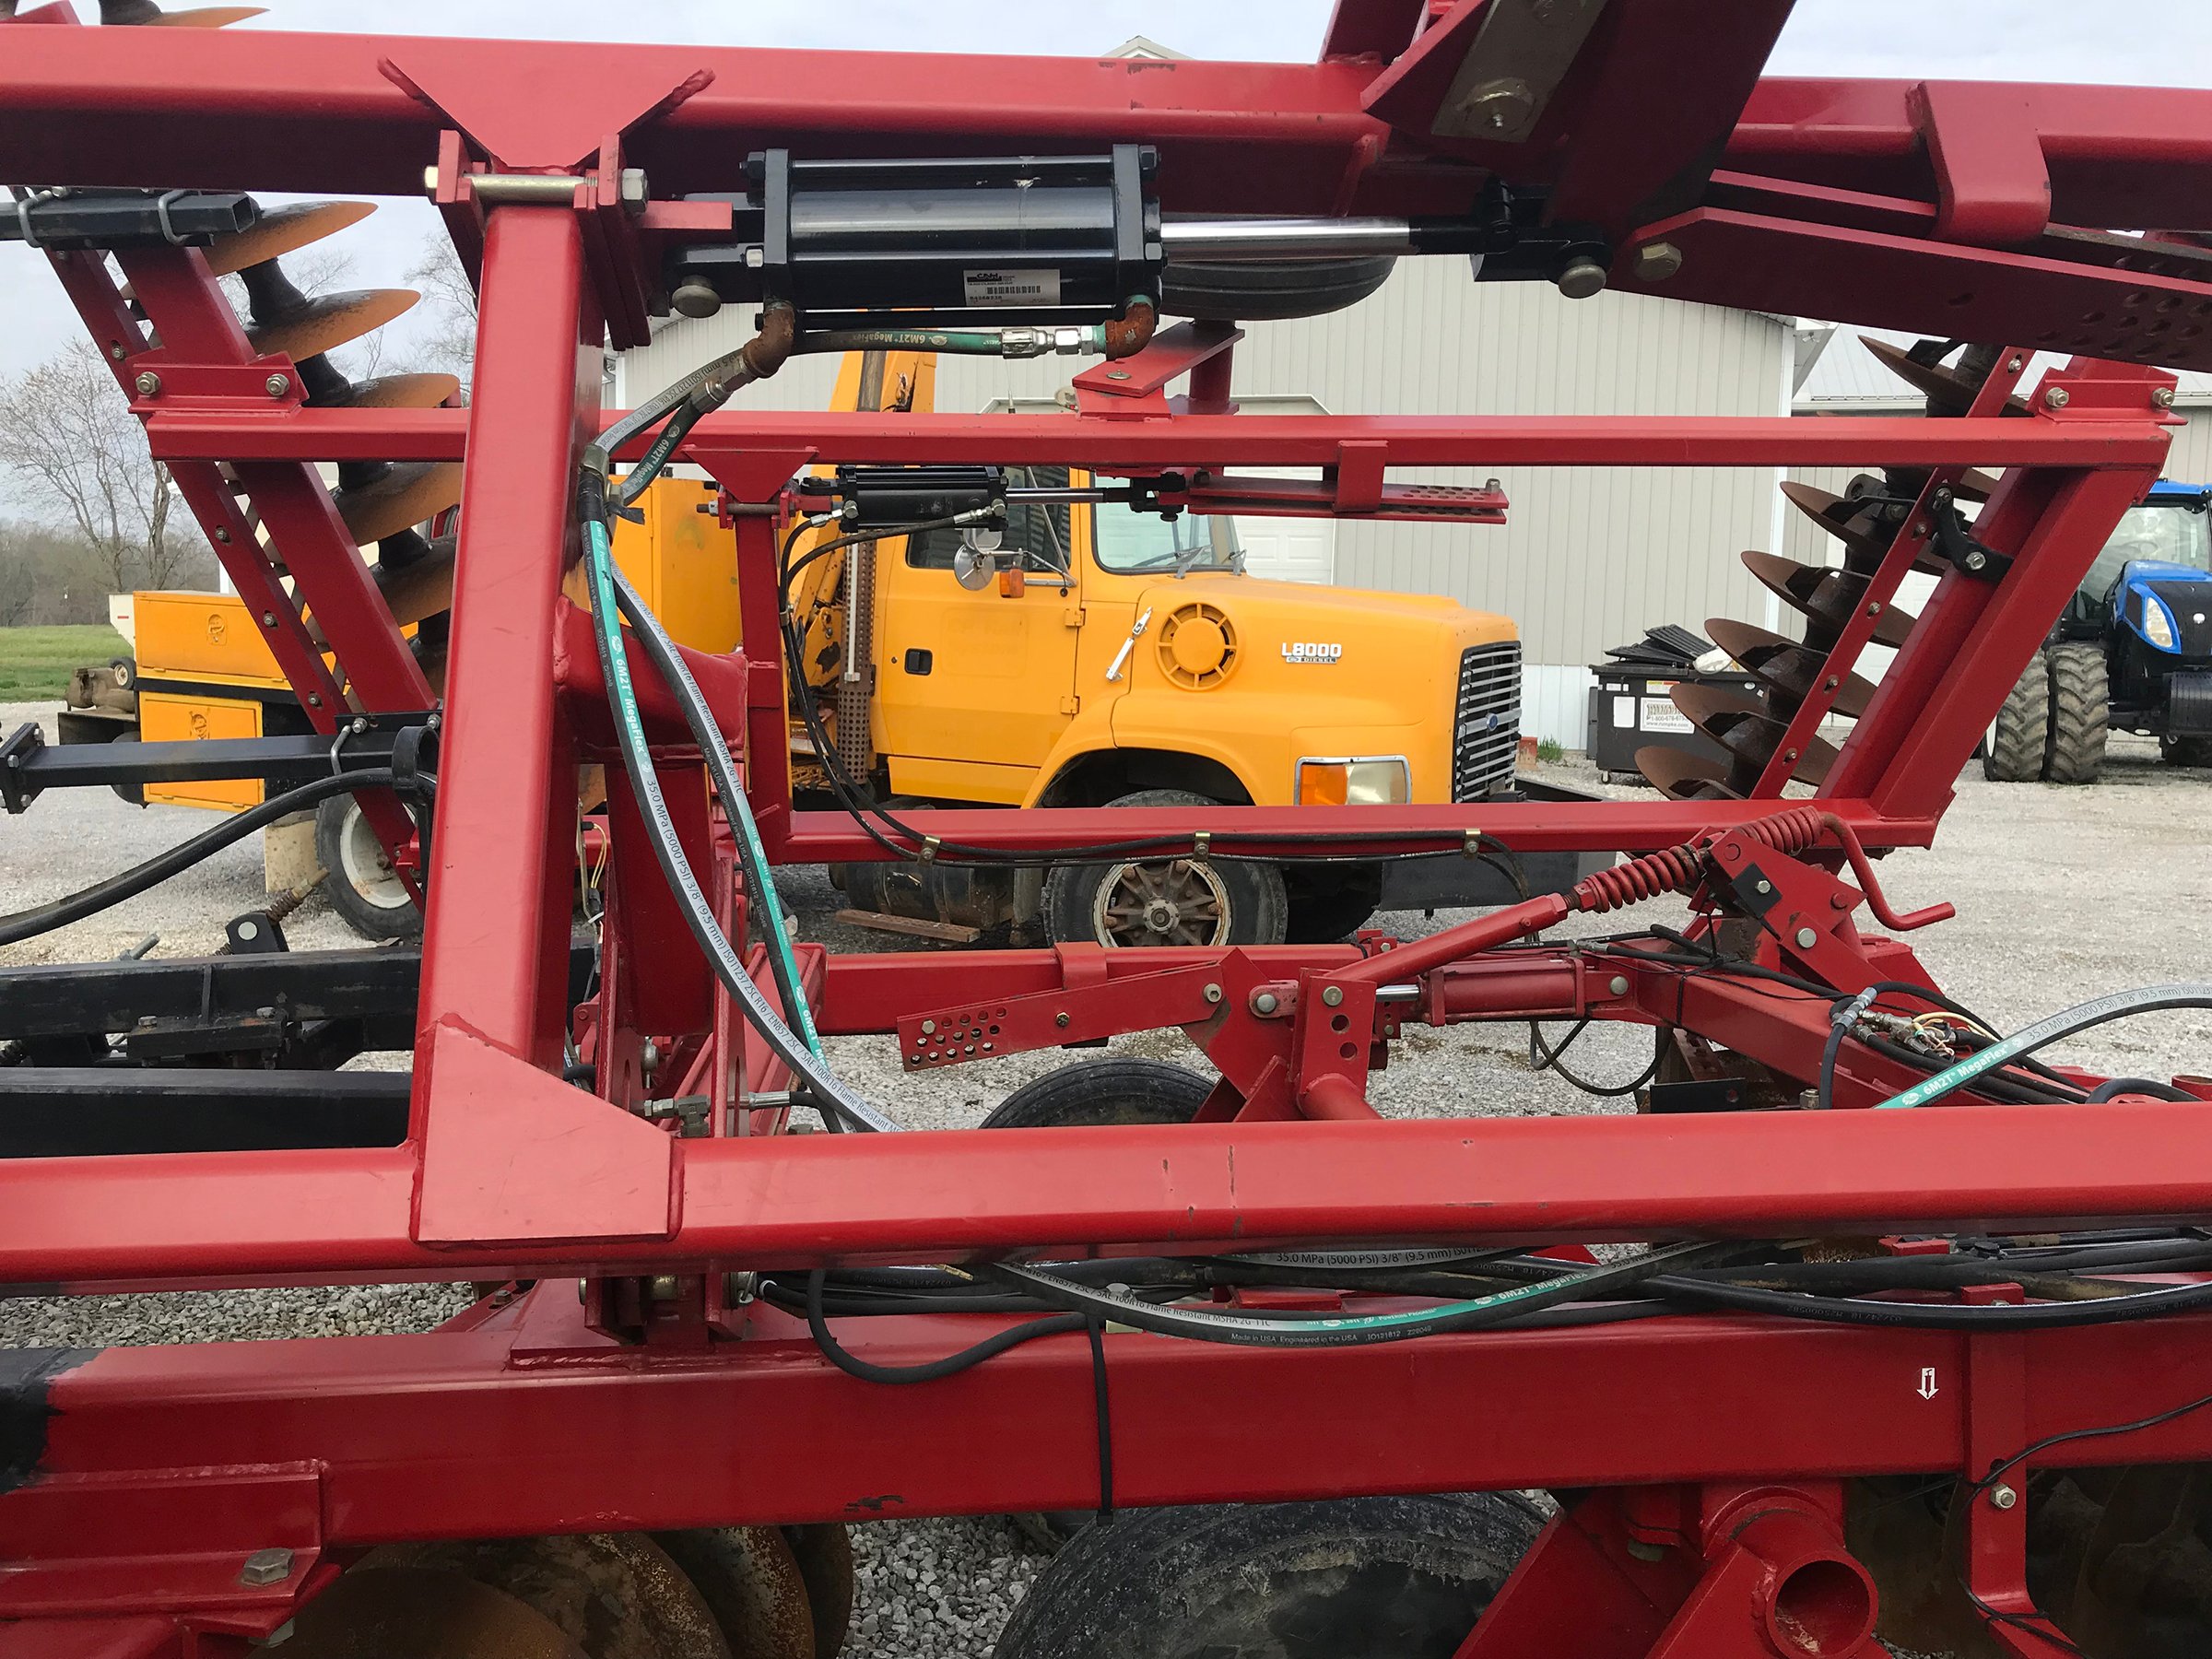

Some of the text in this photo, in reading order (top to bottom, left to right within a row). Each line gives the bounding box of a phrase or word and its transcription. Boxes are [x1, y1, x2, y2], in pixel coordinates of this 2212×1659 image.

[1281, 641, 1342, 658] L8000
[700, 704, 719, 740] Resistant
[717, 740, 732, 765] MSHA
[647, 780, 662, 802] 35.0
[655, 804, 669, 828] MPa
[664, 830, 682, 859] (5000
[677, 860, 693, 881] PSI)
[697, 904, 714, 924] (9.5
[709, 925, 727, 949] mm)
[723, 948, 747, 983] ISO11237
[744, 983, 758, 999] 2SC
[754, 997, 768, 1014] R16
[768, 1015, 791, 1038] EN857
[785, 1033, 801, 1051] 2SC
[800, 1052, 815, 1067] SAE
[814, 1065, 838, 1091] 100R16
[836, 1085, 859, 1107] Flame
[857, 1102, 888, 1130] Resistant
[2028, 1025, 2049, 1041] 35.0
[2048, 1015, 2071, 1031] MPa
[2072, 1006, 2099, 1022] (5000
[2098, 996, 2119, 1012] PSI)
[2137, 988, 2159, 1002] (9.5
[2159, 985, 2182, 996] mm)
[1276, 1252, 1299, 1264] 35.0
[1301, 1253, 1324, 1265] MPa
[1326, 1253, 1357, 1265] (5000
[1359, 1253, 1379, 1265] PSI)
[1382, 1251, 1402, 1264] 3/8"
[1405, 1250, 1425, 1263] (9.5
[1428, 1247, 1452, 1260] mm)
[1147, 1302, 1172, 1315] Flame
[1173, 1309, 1211, 1322] Resistant
[1213, 1314, 1238, 1324] MSHA
[1341, 1334, 1358, 1342] USA
